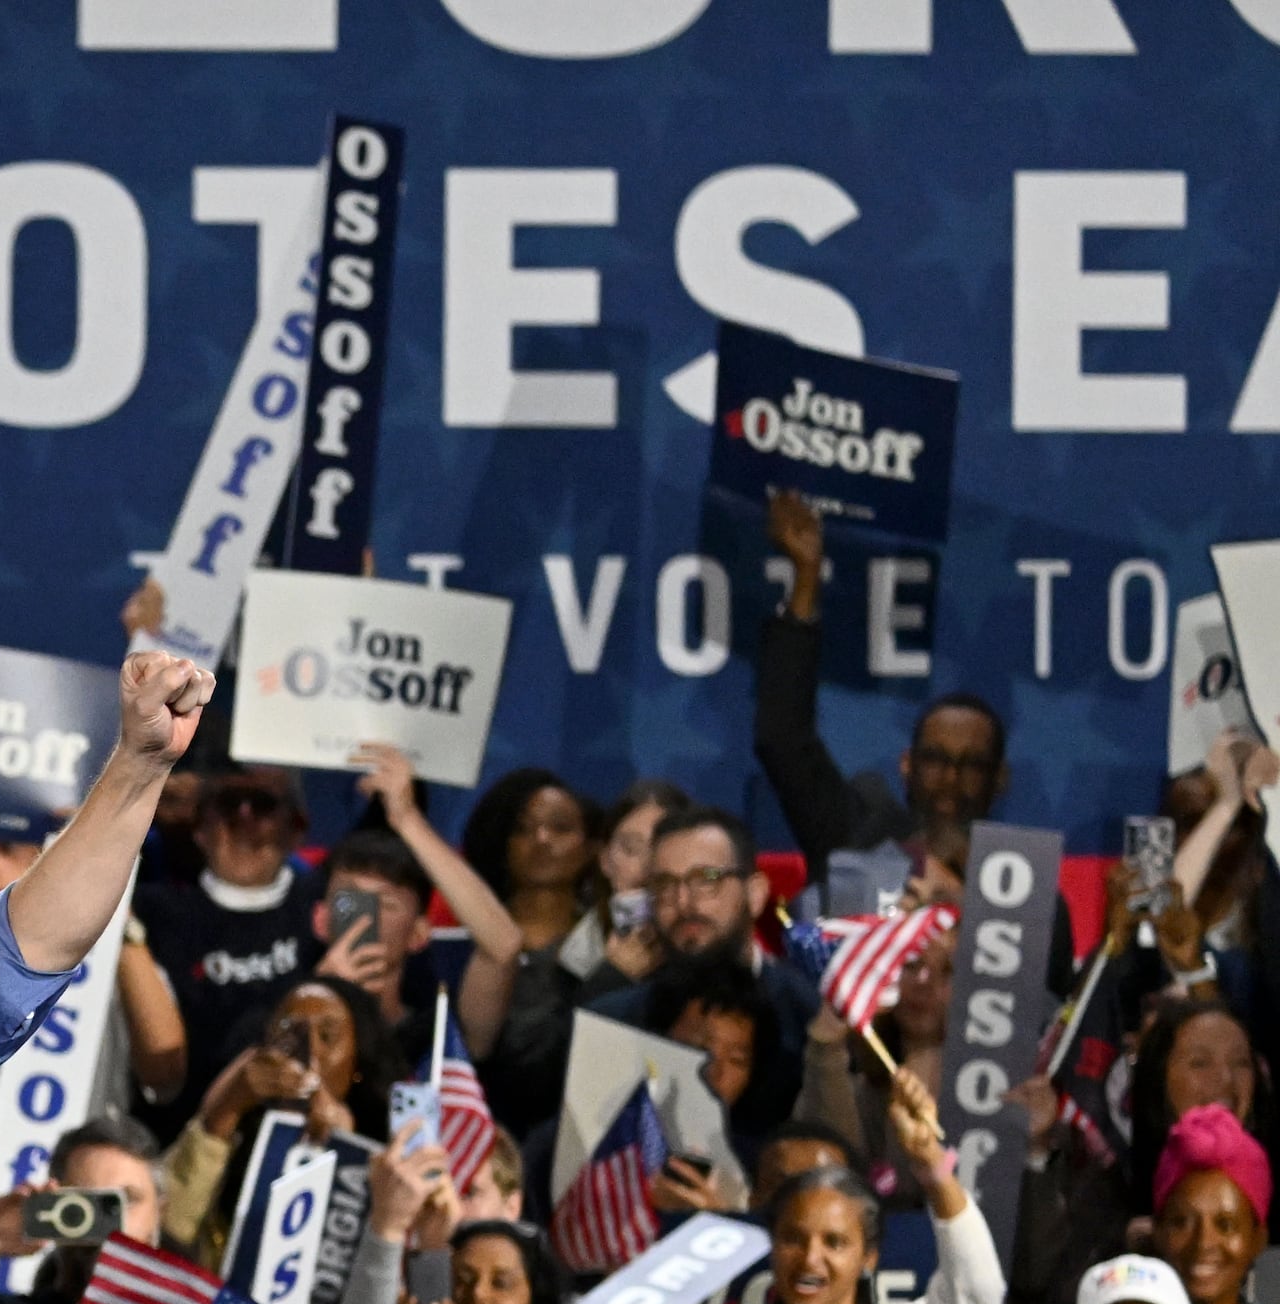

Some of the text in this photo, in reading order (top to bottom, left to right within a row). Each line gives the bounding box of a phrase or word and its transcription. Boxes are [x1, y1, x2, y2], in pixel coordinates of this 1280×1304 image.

[782, 376, 864, 432] Jon
[743, 397, 925, 483] Ossoff
[337, 617, 423, 664] Jon
[1017, 560, 1169, 681] TO
[282, 648, 475, 715] Ossoff
